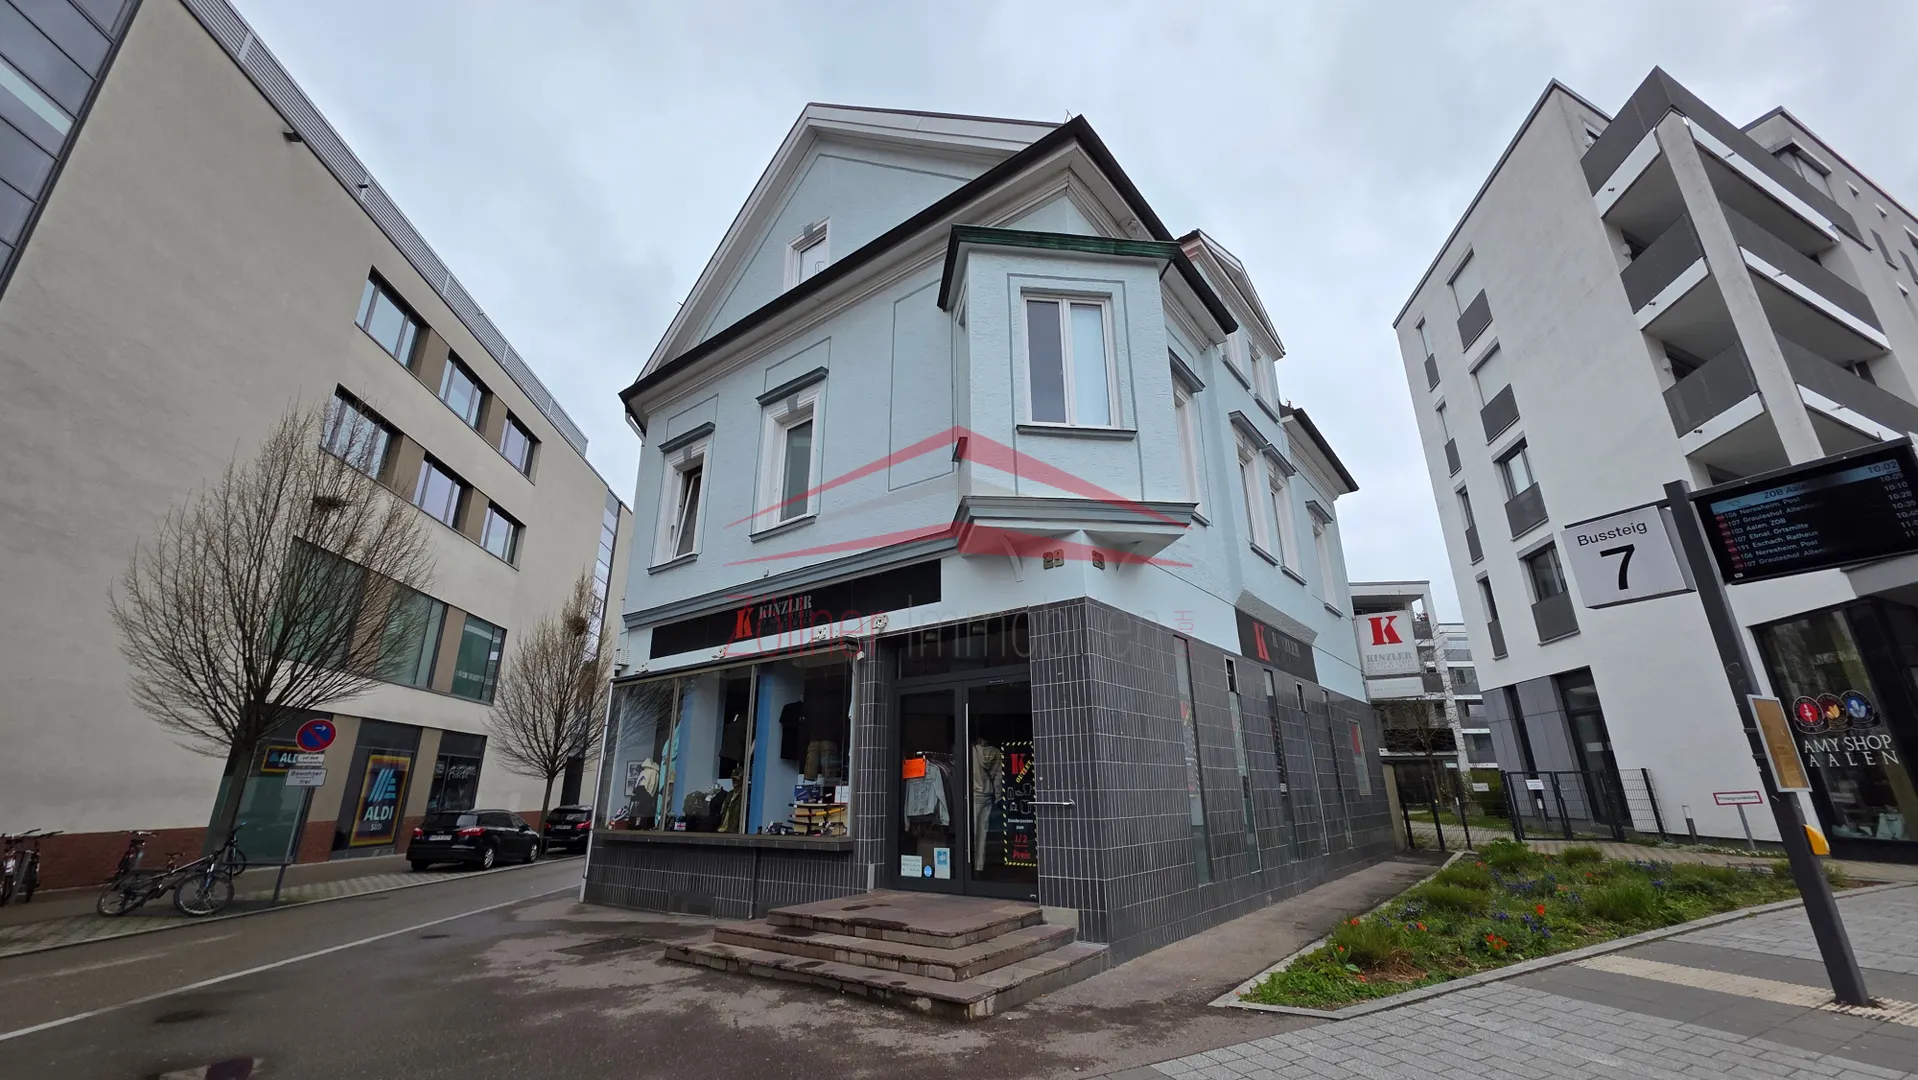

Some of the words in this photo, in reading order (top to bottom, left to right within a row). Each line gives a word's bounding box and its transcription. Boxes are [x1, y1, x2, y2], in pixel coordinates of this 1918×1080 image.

[1763, 488, 1784, 500] ZOB
[1783, 496, 1801, 505] Post
[1728, 519, 1741, 528] 107
[1770, 517, 1787, 527] ZOB
[1577, 522, 1648, 547] Bussteig
[1734, 535, 1747, 543] 107
[1773, 523, 1809, 535] Ortsmitte
[1786, 530, 1819, 541] Rathaus
[1800, 539, 1819, 549] Post
[1599, 543, 1636, 591] 7
[1744, 560, 1756, 569] 107
[758, 594, 813, 620] KINZLER
[735, 607, 755, 640] K
[1368, 615, 1404, 646] K
[1252, 621, 1271, 662] K
[1366, 651, 1414, 663] KINZLER
[1804, 737, 1840, 754] AMY
[1843, 734, 1892, 752] SHOP
[1010, 753, 1027, 776] K
[1809, 750, 1900, 768] AALEN
[1015, 759, 1033, 784] OUTLET
[363, 805, 395, 822] ALDI
[1012, 850, 1032, 860] Preis
